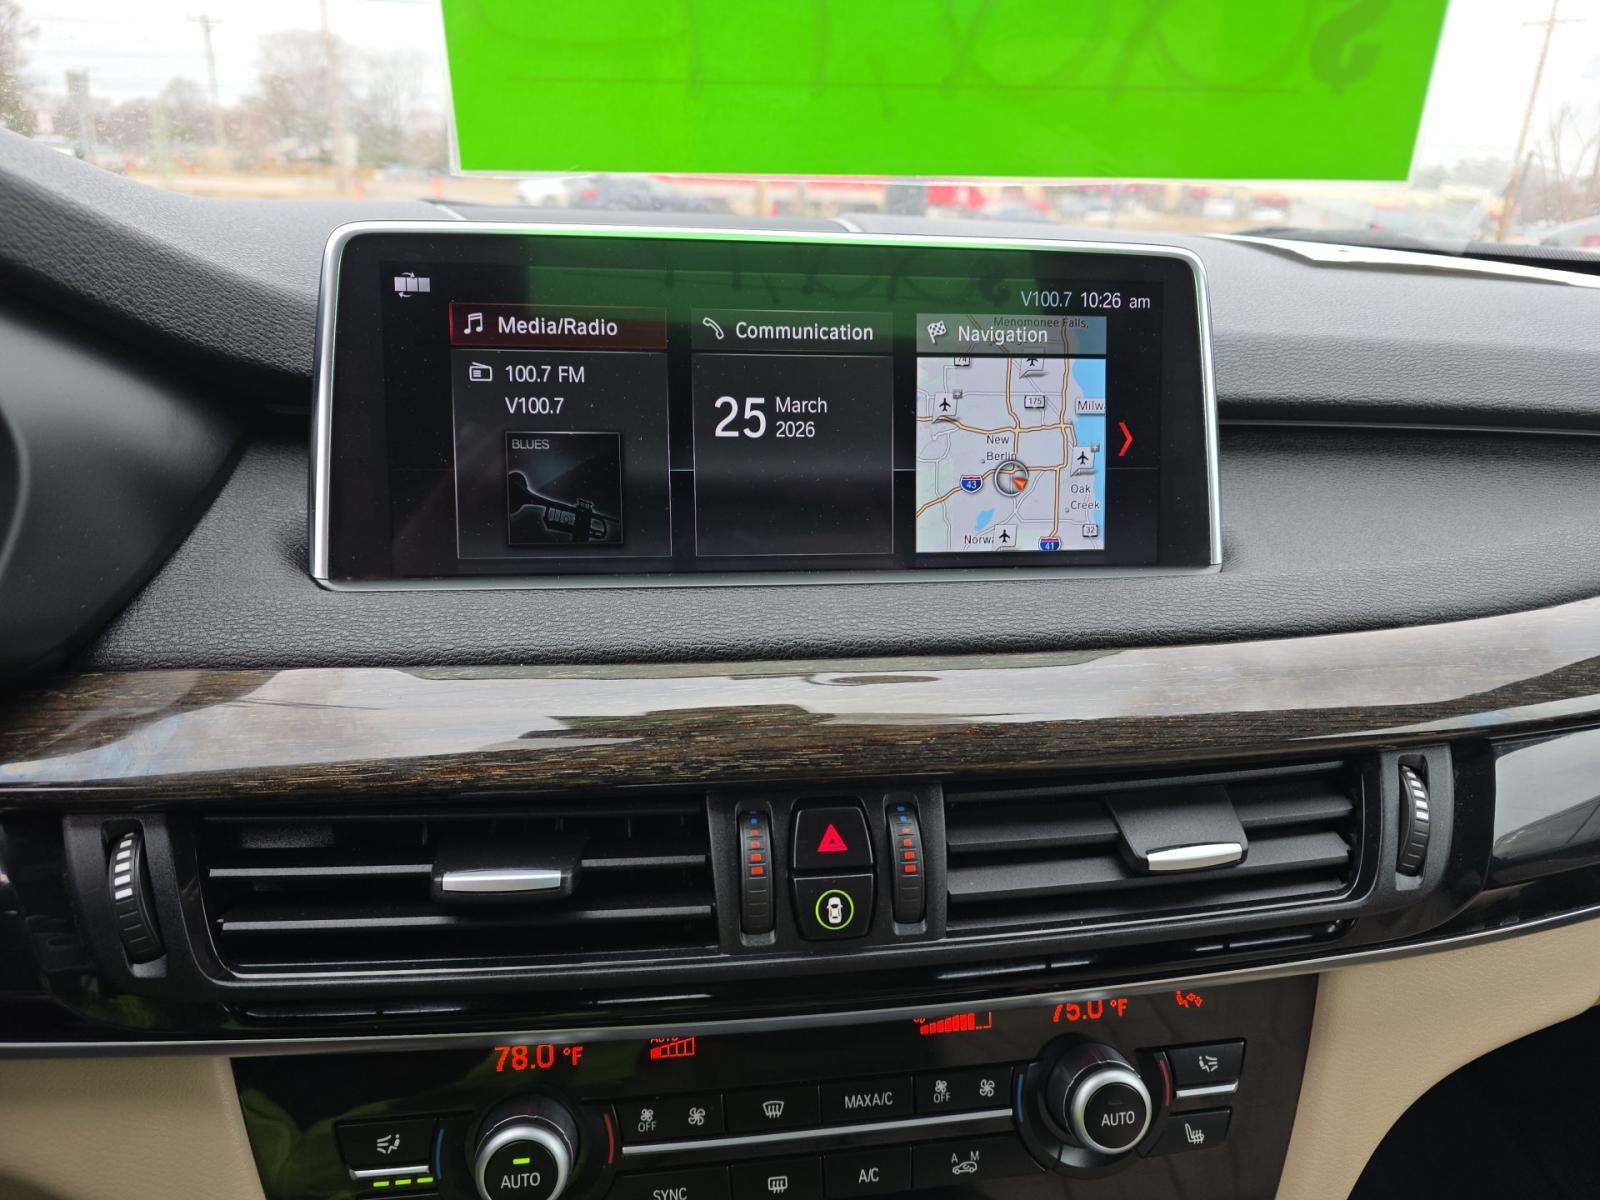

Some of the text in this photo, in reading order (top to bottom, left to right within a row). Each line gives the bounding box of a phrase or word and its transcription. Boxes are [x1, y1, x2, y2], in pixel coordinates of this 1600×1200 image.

[1020, 291, 1151, 309] V100.7 10:26 am
[498, 316, 618, 336] Media/Radio
[993, 317, 1060, 327] Menomonee
[736, 321, 874, 341] Communication
[958, 325, 1049, 344] Navigation
[505, 365, 585, 383] 100.7 FM
[505, 397, 564, 415] V100.7
[775, 397, 828, 413] March
[1028, 397, 1042, 406] 175
[1077, 400, 1105, 411] Milw
[714, 395, 767, 439] 25
[776, 421, 816, 438] 2026
[511, 438, 550, 450] BLUES
[986, 434, 1009, 445] New
[986, 451, 1017, 462] Berlin
[965, 480, 977, 489] 43
[1070, 484, 1091, 494] Oak
[1070, 500, 1100, 510] Creek
[1085, 526, 1095, 534] 32
[1044, 542, 1055, 550] 41
[494, 1044, 554, 1072] 78.0
[933, 1093, 951, 1104] OFF
[1101, 1110, 1136, 1127] AUTO
[637, 1121, 657, 1133] OFF
[951, 1150, 980, 1163] A M
[500, 1172, 541, 1189] AUTO
[858, 1167, 880, 1184] A/C
[653, 1187, 688, 1200] SYNC
